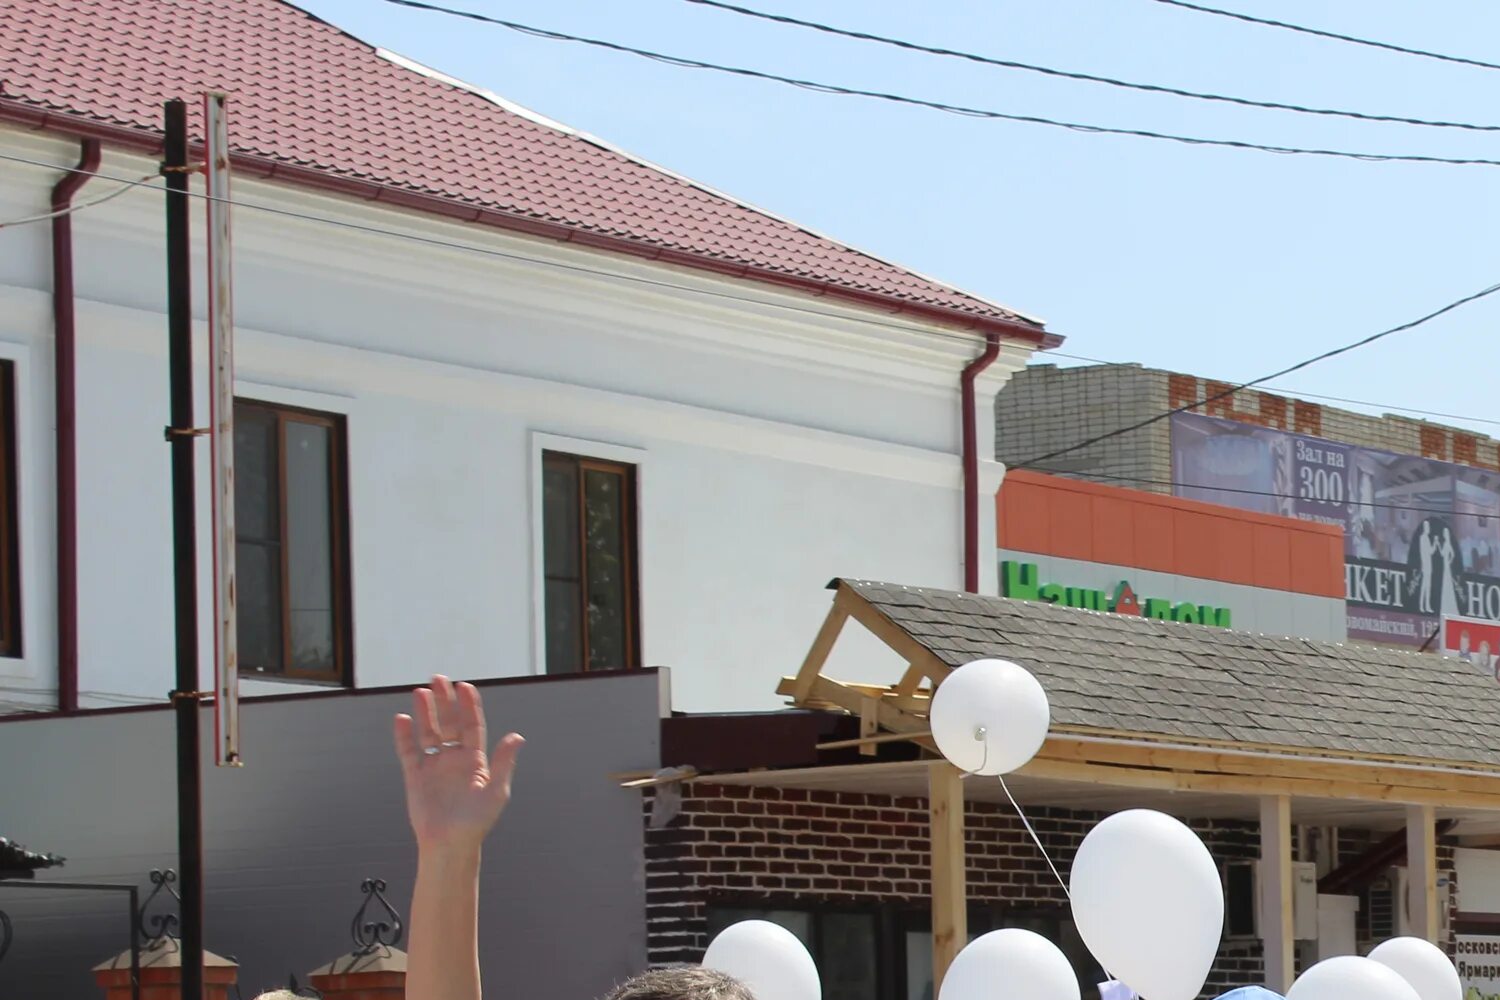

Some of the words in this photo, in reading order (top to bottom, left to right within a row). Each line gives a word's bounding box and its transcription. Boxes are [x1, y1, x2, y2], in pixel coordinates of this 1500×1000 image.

[1296, 440, 1323, 464] Зал
[1326, 450, 1345, 468] на
[1300, 466, 1343, 507] 300
